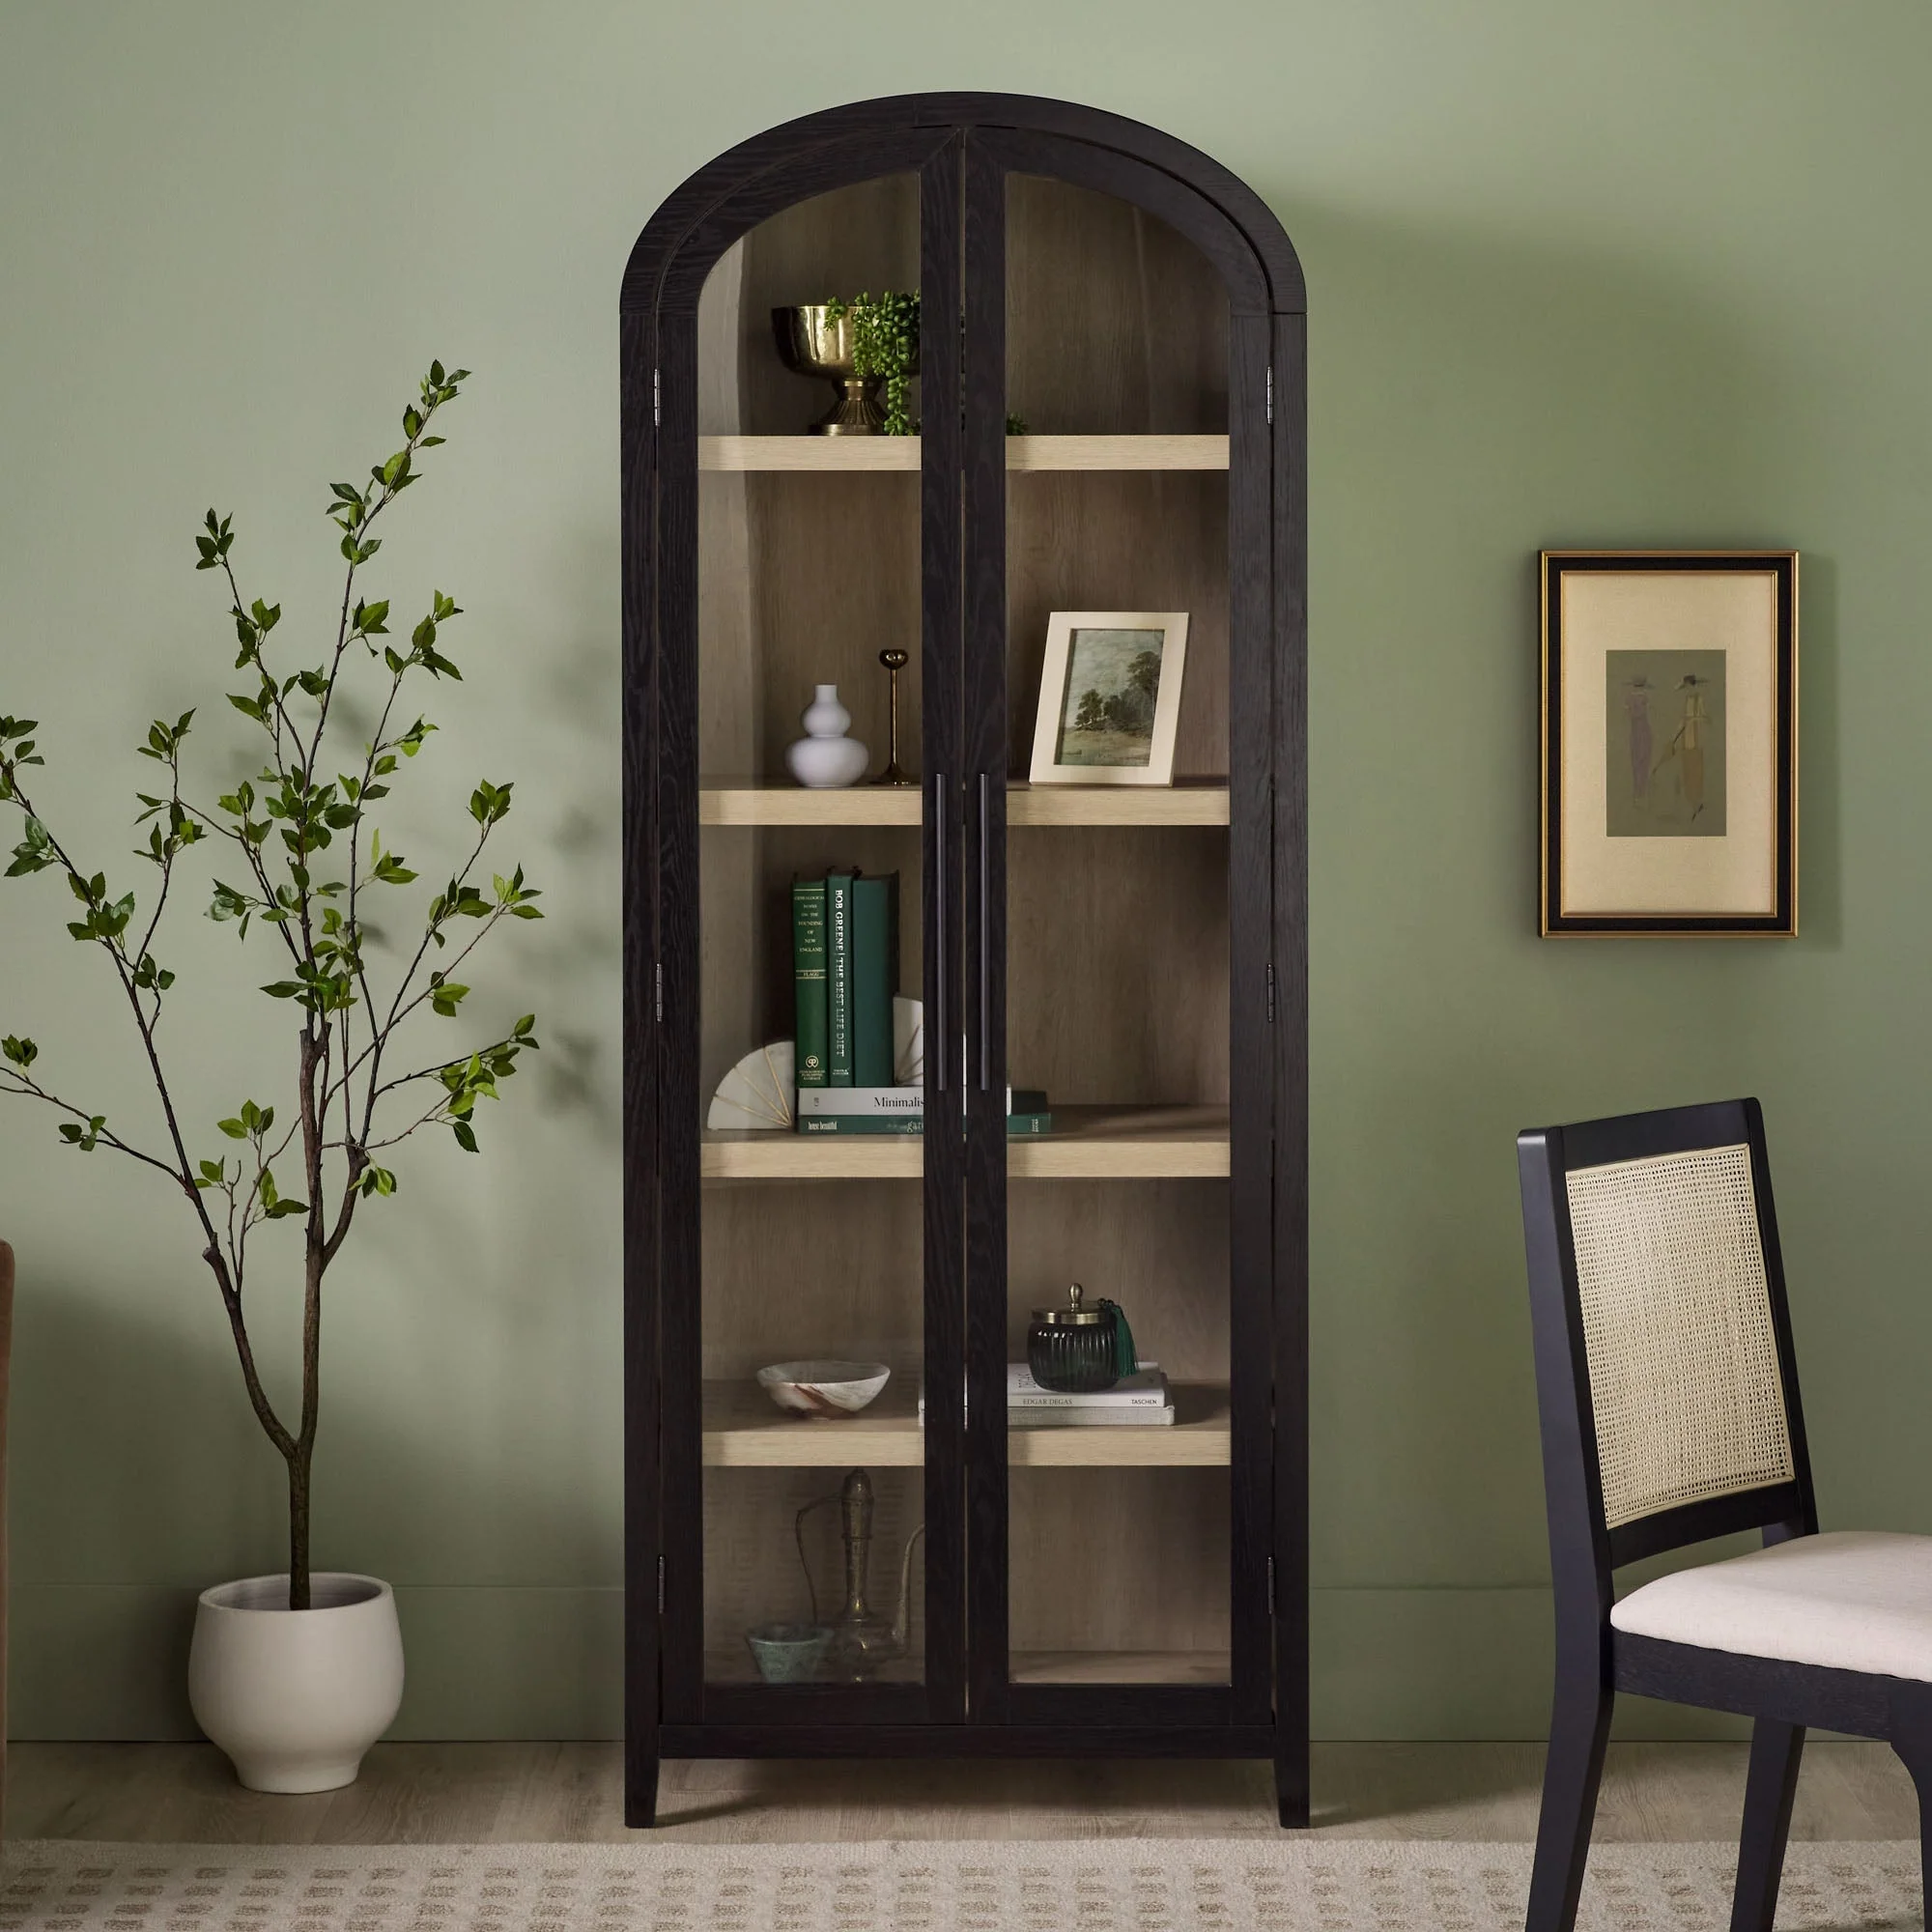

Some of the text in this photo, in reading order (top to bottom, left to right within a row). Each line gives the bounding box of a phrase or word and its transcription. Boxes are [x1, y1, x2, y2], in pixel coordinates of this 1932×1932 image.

[835, 889, 844, 1057] BOB GREENE THE BEST LIFE DIET
